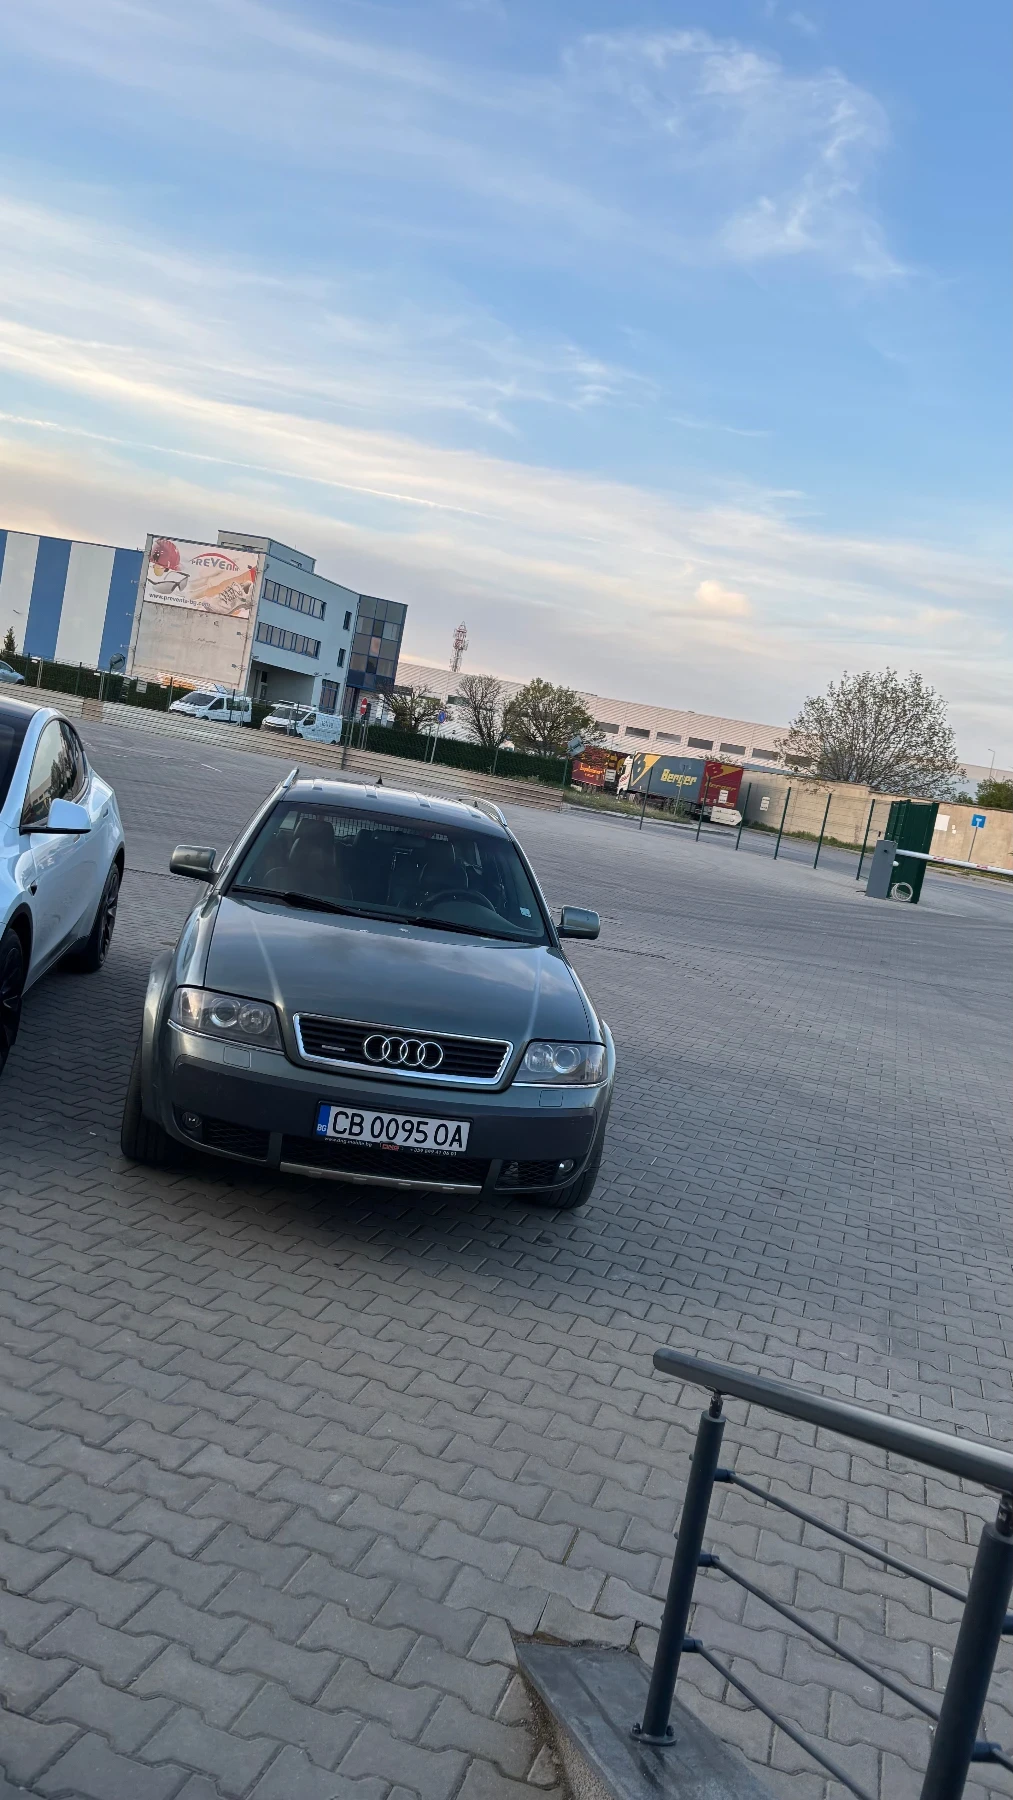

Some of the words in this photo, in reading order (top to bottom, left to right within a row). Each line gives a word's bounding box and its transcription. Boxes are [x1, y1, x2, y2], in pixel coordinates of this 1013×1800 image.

[660, 768, 698, 787] Berger
[316, 1123, 328, 1132] BG
[332, 1110, 365, 1137] CB
[370, 1115, 429, 1144] 0095
[433, 1123, 463, 1149] OA
